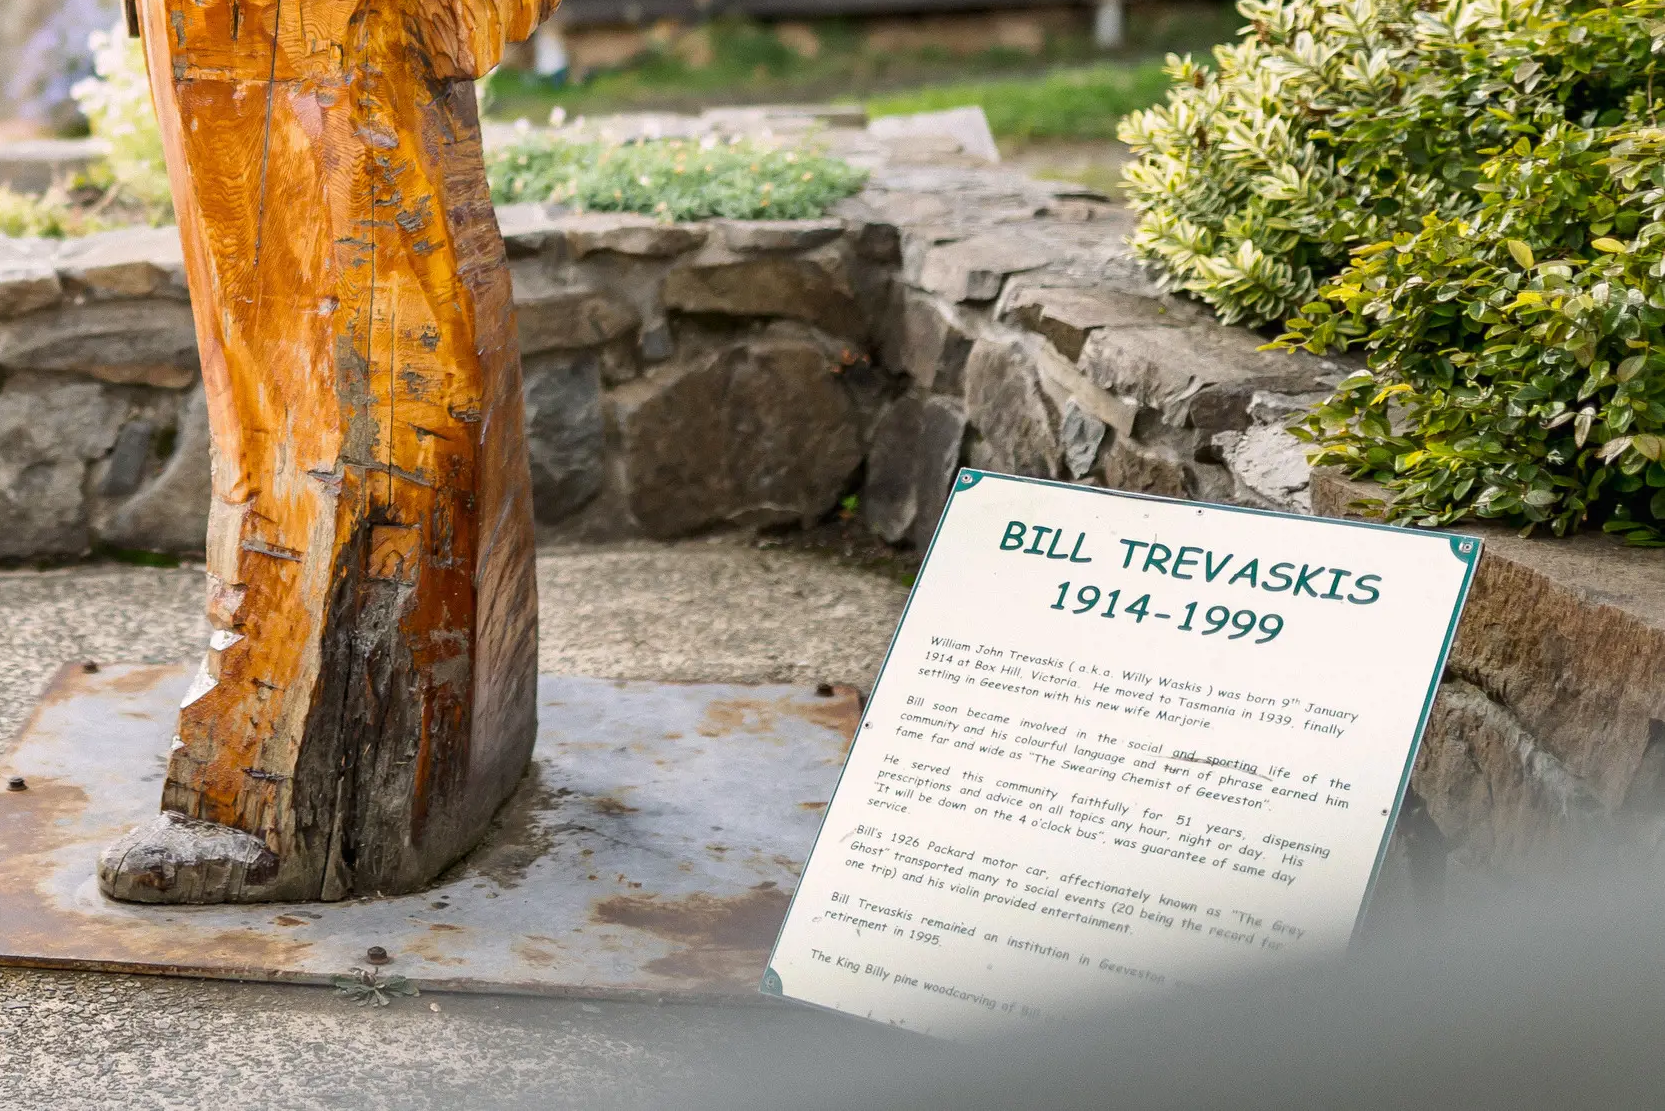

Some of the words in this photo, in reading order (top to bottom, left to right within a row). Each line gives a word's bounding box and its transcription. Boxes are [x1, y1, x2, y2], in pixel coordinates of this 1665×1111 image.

[998, 520, 1092, 563] BILL
[1118, 537, 1382, 605] TREVASKIS
[1049, 580, 1284, 644] 1914-1999
[916, 667, 961, 684] settling
[964, 676, 975, 685] in
[978, 676, 1039, 696] Geeveston
[1042, 691, 1069, 702] with
[1073, 693, 1091, 707] his
[1095, 700, 1120, 711] new
[1123, 705, 1150, 717] wife
[924, 650, 953, 663] 1914
[956, 658, 970, 667] at
[973, 659, 996, 672] Box
[999, 664, 1022, 679] Hill,
[1031, 669, 1081, 689] Victoria.
[1092, 681, 1110, 693] He
[1114, 687, 1154, 701] moved
[1158, 693, 1172, 704] to
[1178, 696, 1236, 716] Tasmania
[1240, 709, 1253, 719] in
[1258, 710, 1294, 729] 1939,
[1302, 718, 1345, 739] finally
[930, 635, 971, 651] William
[974, 643, 1004, 657] John
[1009, 649, 1064, 669] Trevaskis
[1121, 669, 1153, 686] Willy
[1158, 676, 1202, 693] Waskis
[1217, 689, 1241, 700] was
[1245, 691, 1276, 706] born
[1303, 701, 1359, 724] January
[894, 724, 924, 740] fame
[930, 732, 950, 745] far
[952, 740, 976, 751] and
[978, 745, 1005, 757] wide
[1007, 750, 1023, 760] as
[1060, 759, 1117, 782] Swearing
[1120, 771, 1172, 790] Chemist
[1175, 783, 1192, 794] of
[899, 712, 959, 732] community
[962, 725, 985, 736] and
[990, 727, 1008, 740] his
[1013, 735, 1068, 752] colourful
[1072, 744, 1125, 765] language
[1132, 758, 1157, 770] and
[1163, 763, 1190, 776] turn
[1196, 770, 1212, 781] of
[1217, 774, 1263, 791] phrase
[1270, 785, 1319, 802] earned
[1324, 793, 1349, 809] him
[905, 694, 925, 707] Bill
[931, 702, 958, 714] soon
[965, 706, 1010, 724] became
[1018, 717, 1068, 735] involved
[1075, 728, 1087, 739] in
[1097, 732, 1118, 745] the
[1126, 740, 1164, 754] social
[1168, 749, 1196, 763] and
[1203, 755, 1258, 776] sporting
[1267, 764, 1291, 779] life
[1301, 772, 1319, 784] of
[1329, 777, 1351, 791] the
[866, 797, 910, 815] service.
[876, 769, 952, 792] prescriptions
[958, 786, 982, 798] and
[984, 791, 1023, 807] advice
[1028, 801, 1043, 811] on
[1047, 804, 1064, 815] all
[1068, 808, 1105, 825] topics
[1109, 819, 1133, 833] any
[1137, 822, 1170, 840] hour,
[1177, 833, 1212, 847] night
[1216, 842, 1233, 851] or
[1237, 844, 1265, 861] day.
[1280, 853, 1304, 867] His
[882, 752, 900, 765] He
[910, 760, 951, 776] served
[961, 770, 984, 783] this
[994, 779, 1058, 801] community
[1070, 791, 1130, 816] faithfully
[1141, 806, 1163, 820] for
[1174, 813, 1192, 827] 51
[1205, 823, 1245, 840] years,
[1261, 832, 1331, 860] dispensing
[894, 788, 914, 799] will
[917, 791, 932, 804] be
[936, 796, 967, 811] down
[973, 806, 988, 816] on
[993, 809, 1013, 822] the
[1017, 813, 1027, 824] 4
[1030, 817, 1072, 834] o'clock
[1113, 837, 1137, 849] was
[1139, 843, 1206, 864] guarantee
[1211, 856, 1228, 869] of
[1231, 862, 1266, 877] same
[1270, 869, 1296, 887] day
[844, 858, 865, 870] one
[870, 862, 897, 879] trip)
[901, 872, 924, 884] and
[926, 875, 945, 889] his
[949, 883, 980, 898] violin
[981, 891, 1037, 911] provided
[1039, 905, 1133, 935] entertainment.
[855, 823, 883, 839] Bill's
[890, 831, 920, 848] 1926
[926, 839, 976, 861] Packard
[981, 855, 1018, 870] motor
[1024, 865, 1049, 880] car,
[1058, 872, 1151, 904] affectionately
[1157, 892, 1198, 912] known
[1205, 906, 1222, 918] as
[893, 851, 964, 876] transported
[967, 870, 1000, 886] many
[1005, 877, 1019, 889] to
[1023, 883, 1060, 898] social
[1063, 893, 1106, 909] events
[1110, 901, 1134, 916] (20
[1138, 907, 1174, 928] being
[1180, 917, 1203, 932] the
[1260, 936, 1283, 951] for
[823, 909, 888, 932] retirement
[892, 925, 904, 937] in
[908, 928, 942, 947] 1995.
[830, 890, 850, 904] Bill
[858, 896, 913, 921] Trevaskis
[919, 916, 977, 937] remained
[982, 932, 999, 943] an
[1005, 935, 1070, 961] institution
[1077, 952, 1091, 966] in
[1097, 957, 1166, 985] Geeveston
[810, 947, 832, 964] The
[835, 955, 861, 974] King
[863, 962, 891, 982] Billy
[892, 973, 919, 987] pine
[922, 981, 997, 1011] woodcarving
